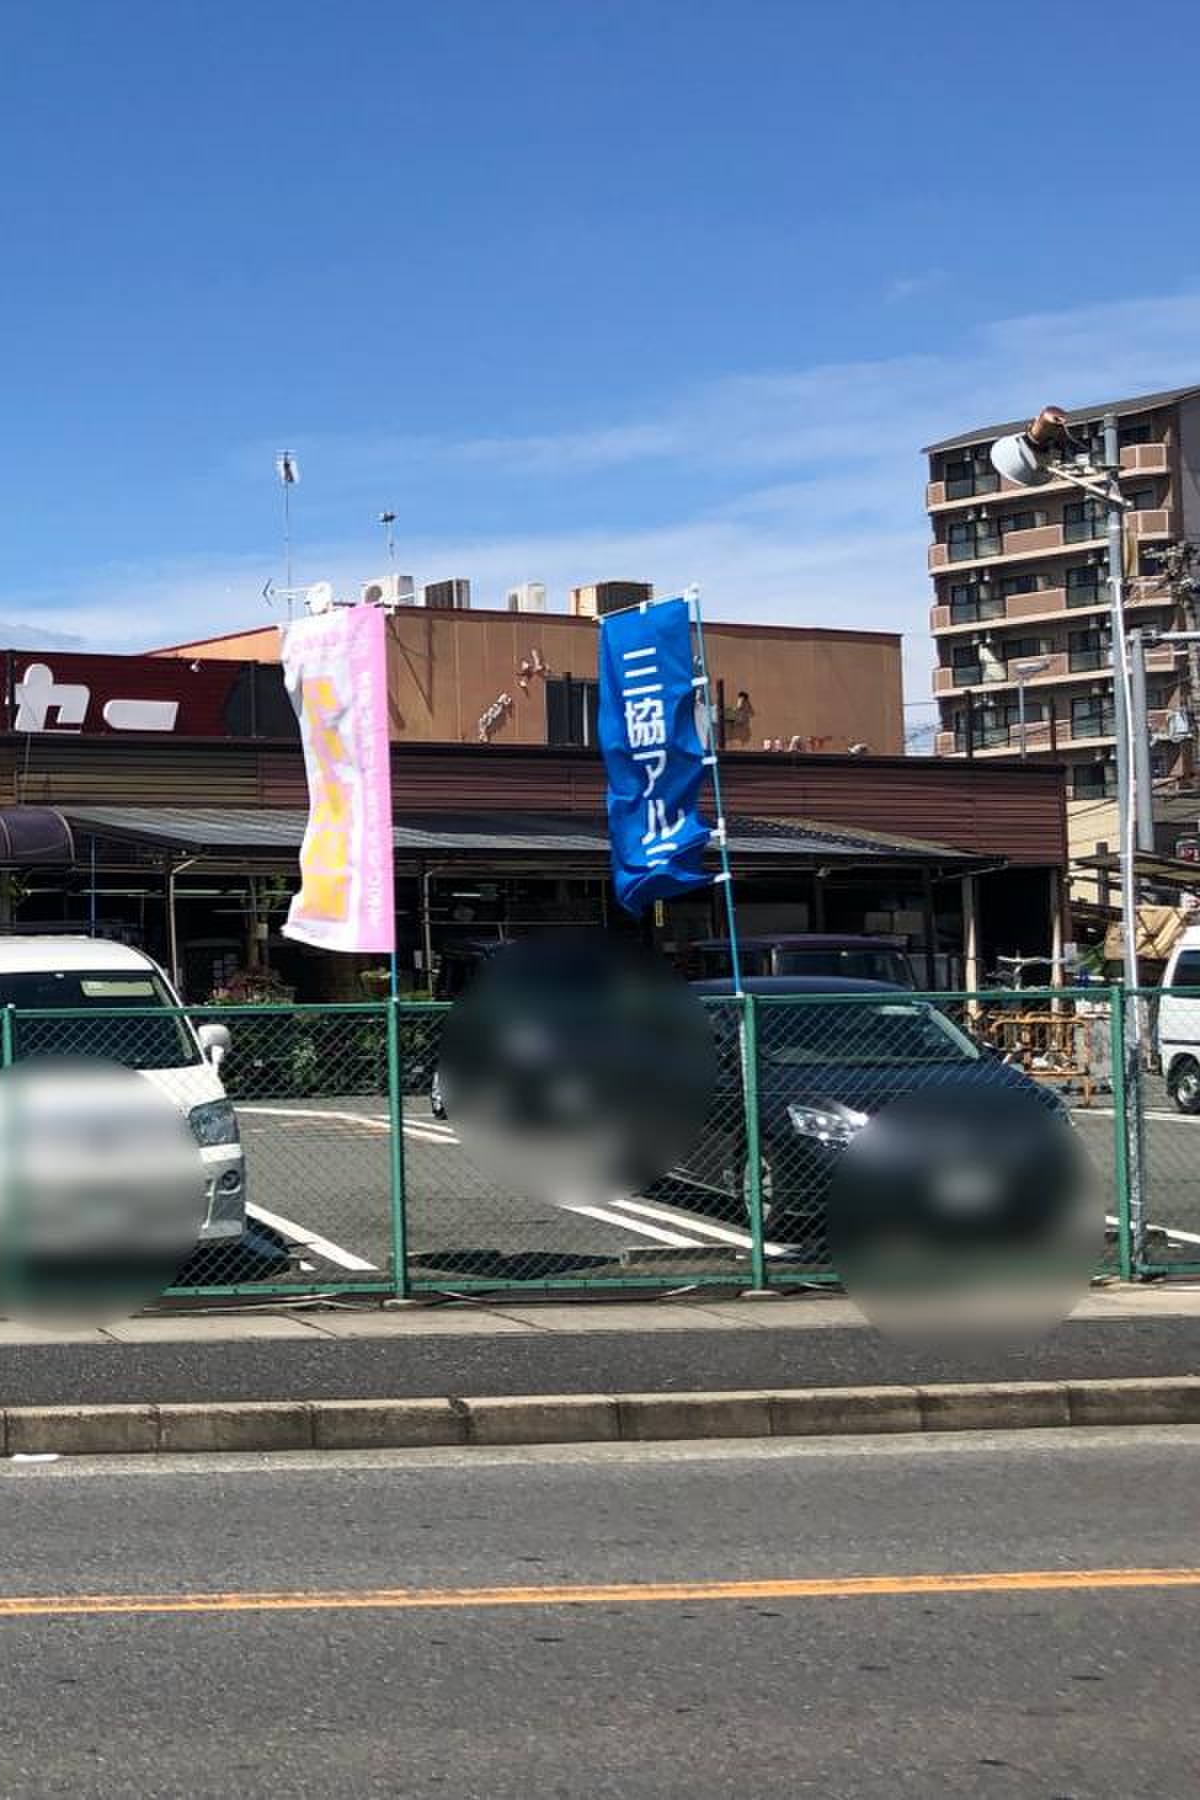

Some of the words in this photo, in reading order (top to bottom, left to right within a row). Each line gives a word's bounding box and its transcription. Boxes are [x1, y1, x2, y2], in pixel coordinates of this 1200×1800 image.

[622, 646, 687, 868] 三協アルミ
